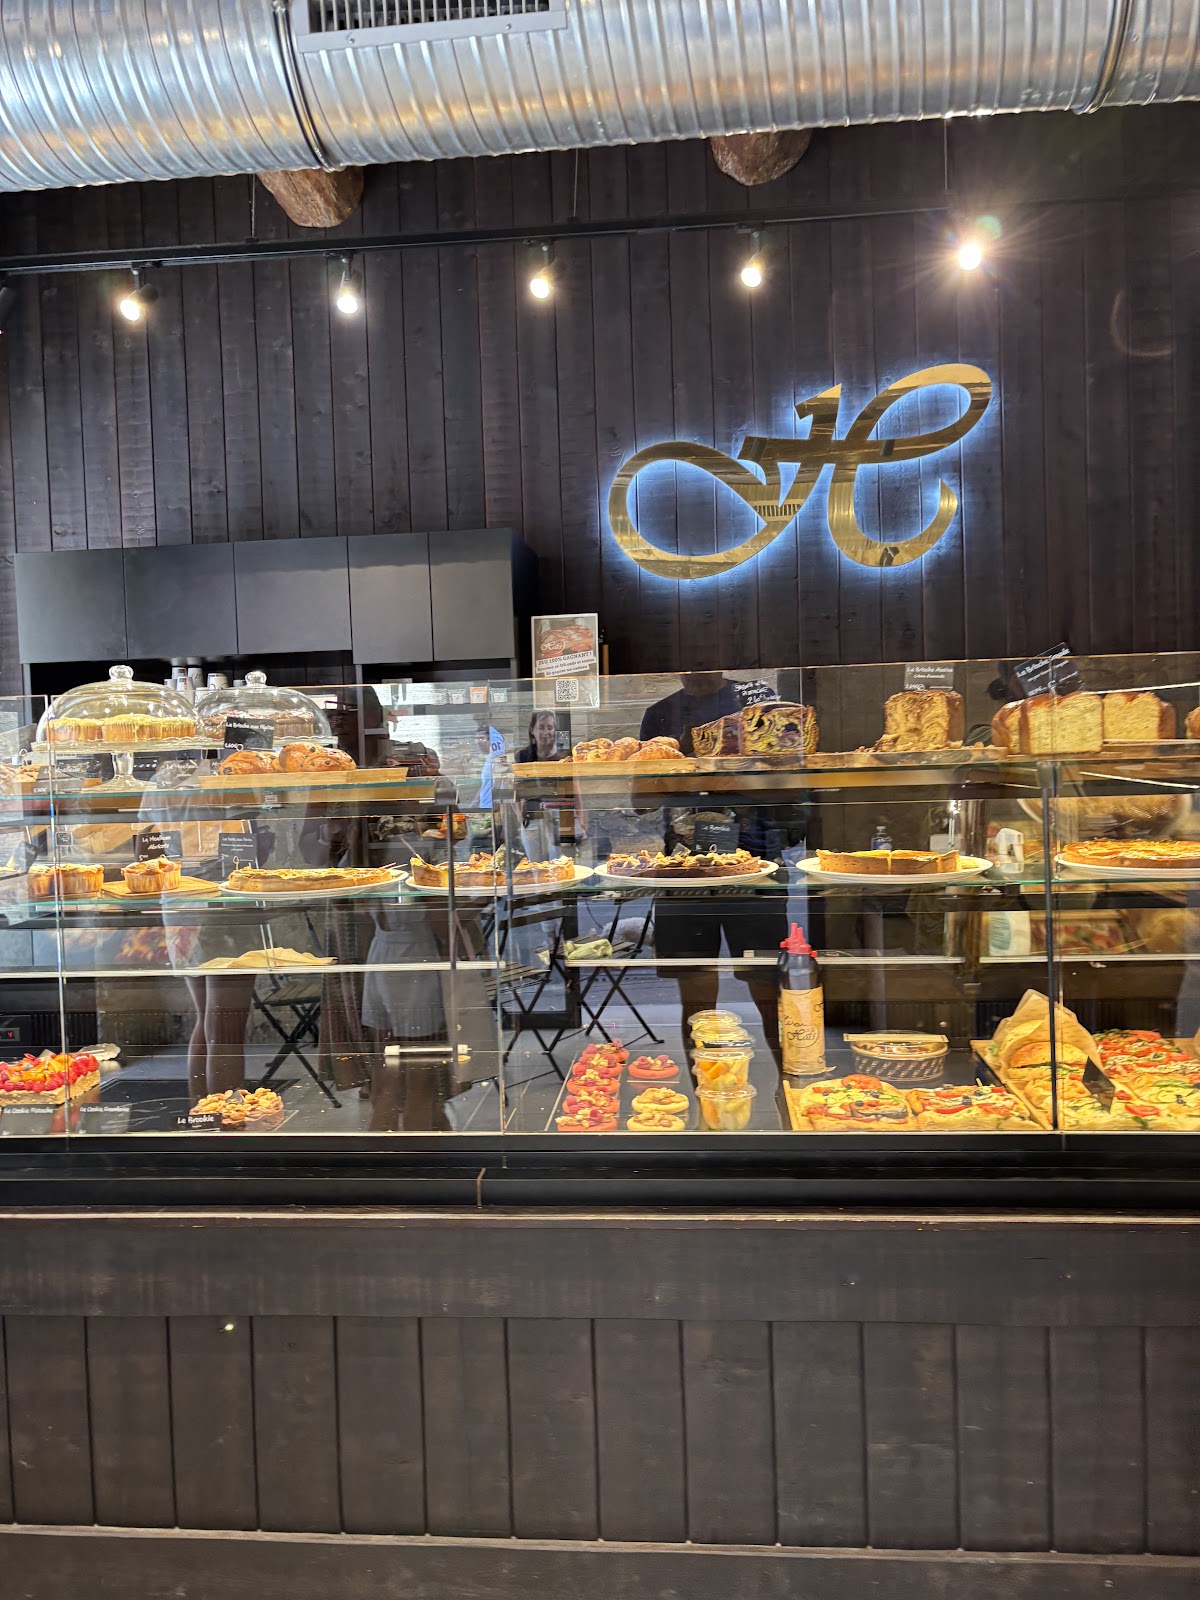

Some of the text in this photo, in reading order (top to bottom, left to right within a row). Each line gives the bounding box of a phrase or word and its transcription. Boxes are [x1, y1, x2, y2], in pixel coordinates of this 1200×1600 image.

[563, 653, 589, 661] GAGNANT
[149, 834, 172, 842] Moelleux
[29, 1106, 54, 1114] Pistache
[87, 1105, 104, 1113] Cookie
[177, 1114, 215, 1124] Le Brookie
